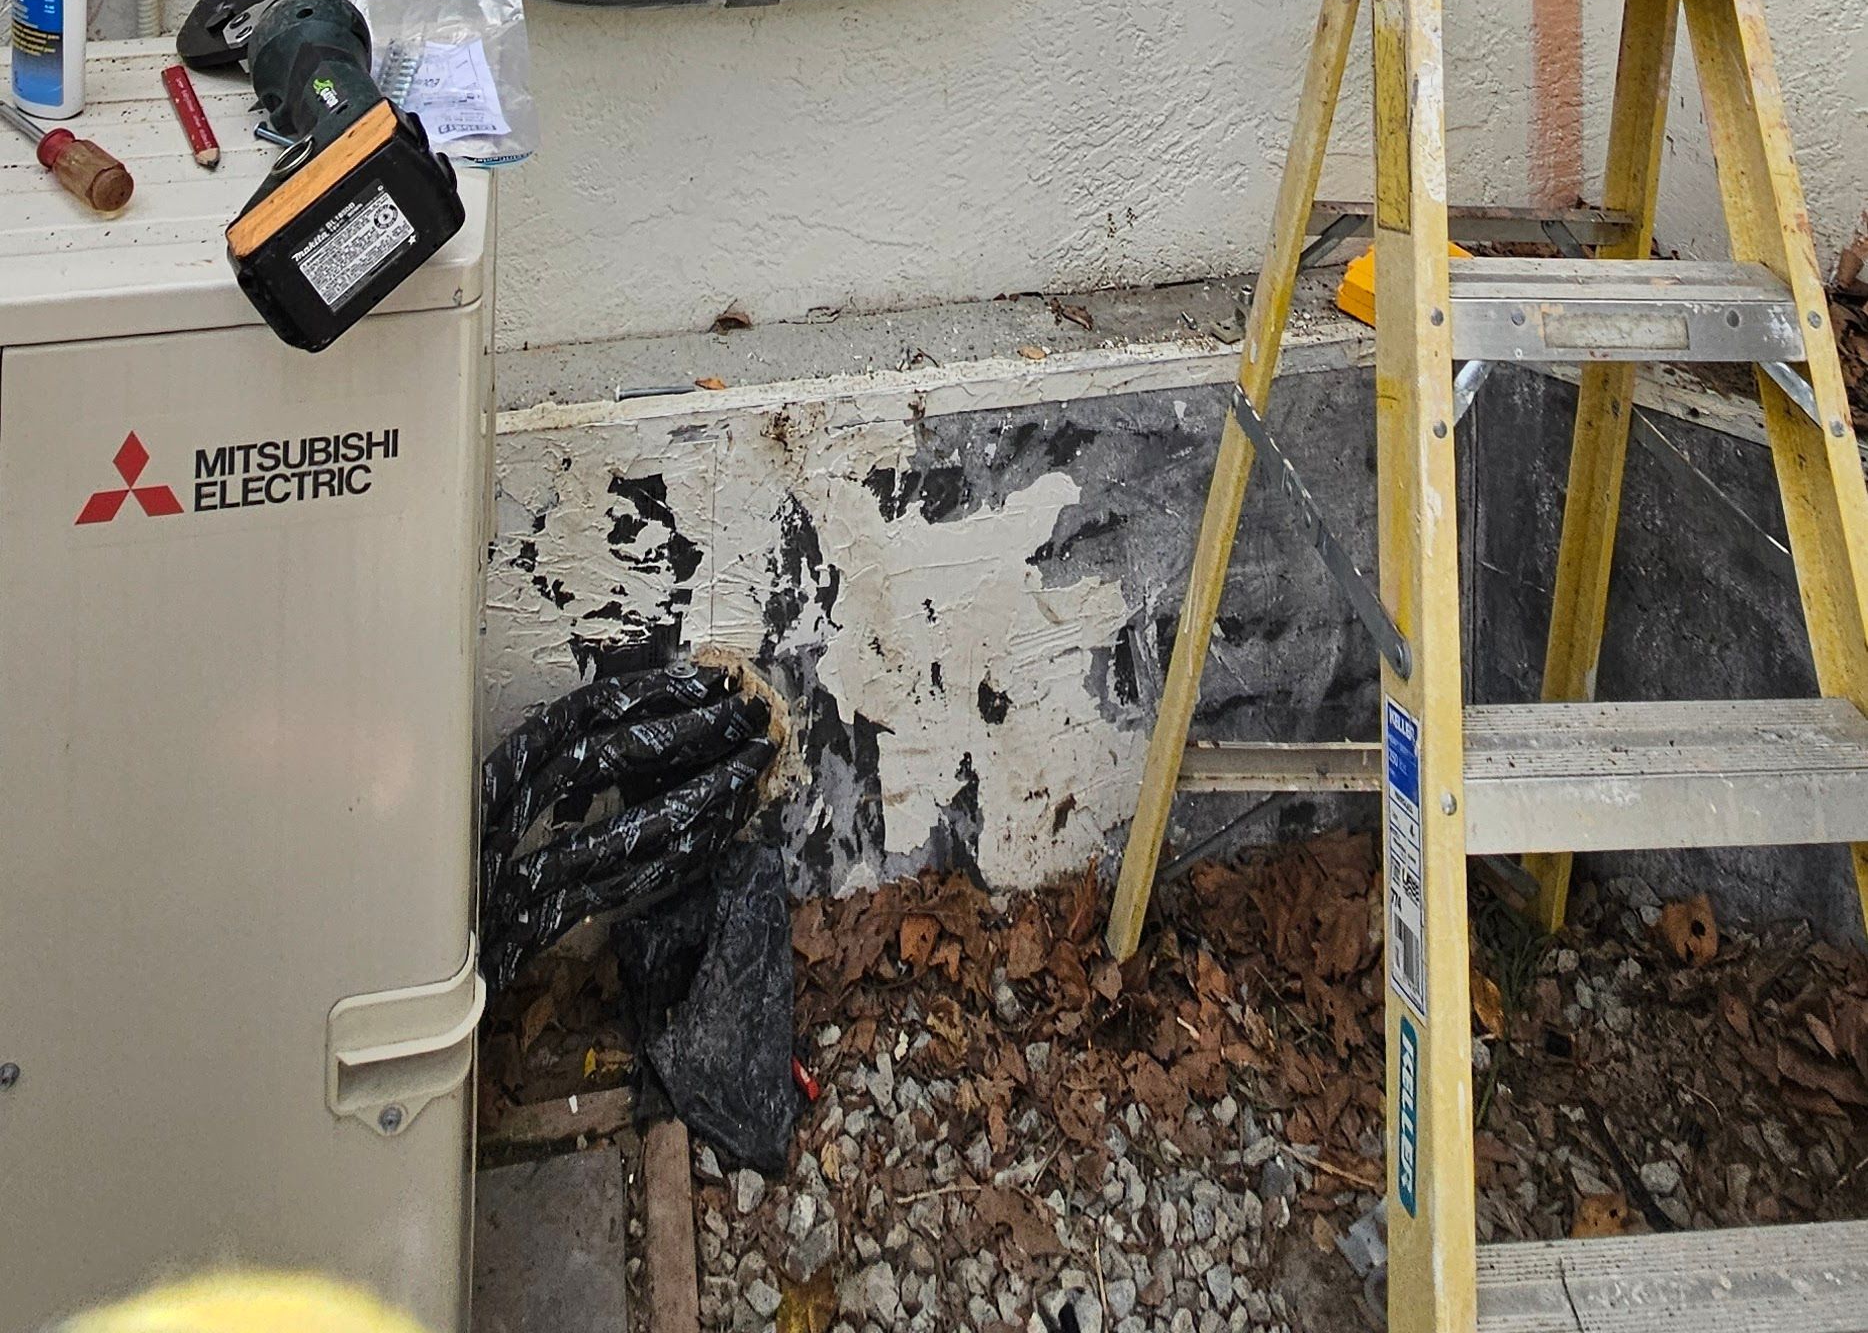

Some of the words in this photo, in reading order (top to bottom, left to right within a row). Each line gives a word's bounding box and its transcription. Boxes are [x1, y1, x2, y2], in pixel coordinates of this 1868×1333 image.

[195, 428, 399, 479] MITSUBISHI
[194, 464, 372, 512] ELECTRIC
[1402, 1032, 1414, 1194] KELLER
